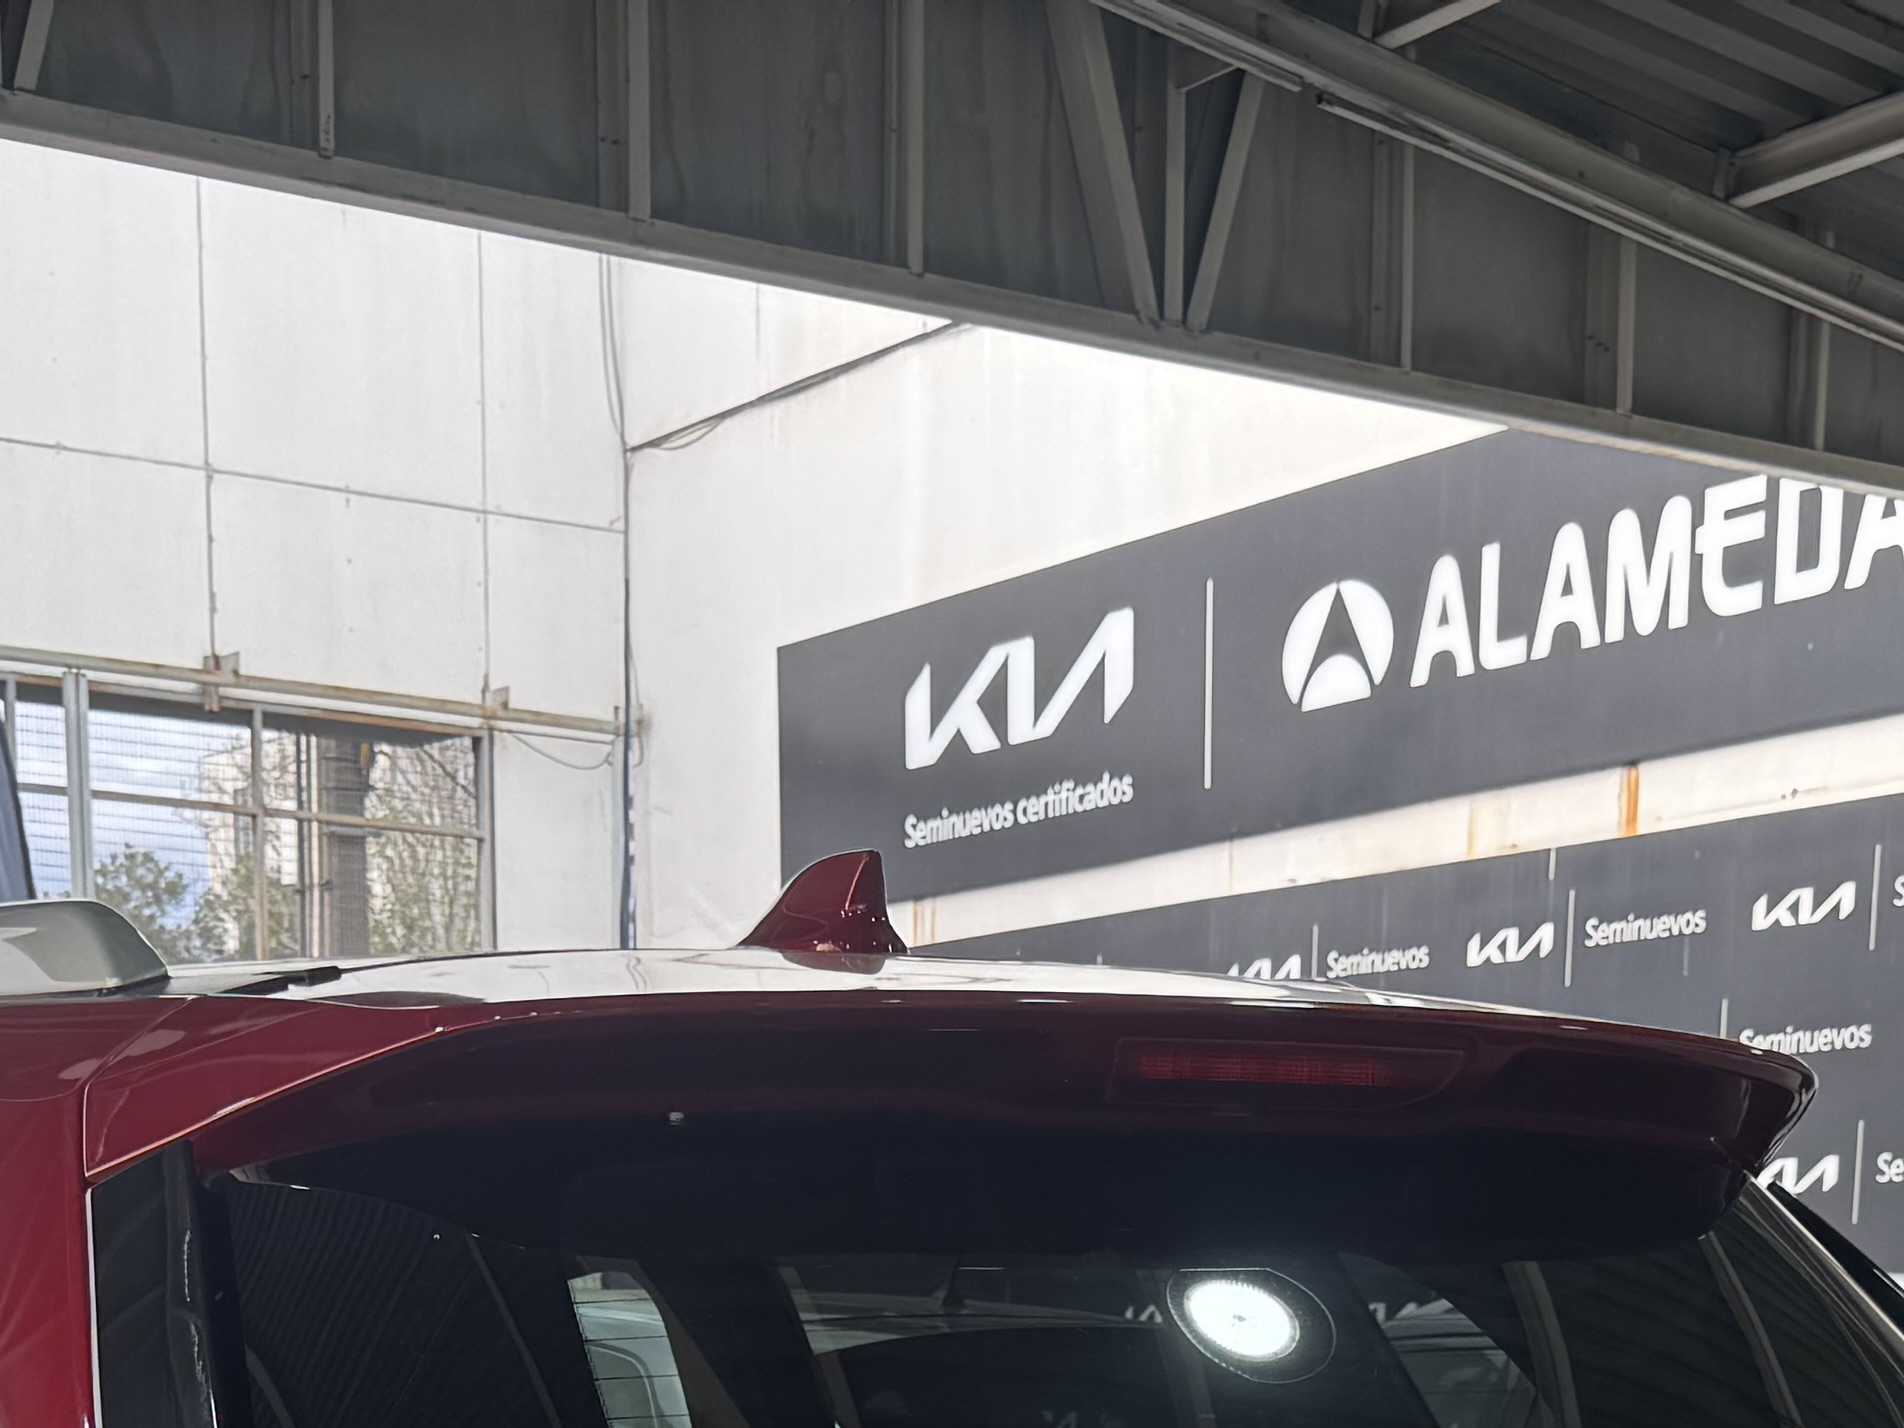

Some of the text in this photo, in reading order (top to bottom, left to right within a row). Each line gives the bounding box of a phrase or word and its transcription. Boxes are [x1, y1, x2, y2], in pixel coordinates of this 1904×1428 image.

[904, 606, 1135, 770] KIA
[904, 771, 1134, 849] Seminuevos certificados
[1751, 880, 1857, 932] KIA
[1326, 944, 1430, 980] Seminuevos
[1466, 908, 1707, 968] KIA Seminuevos
